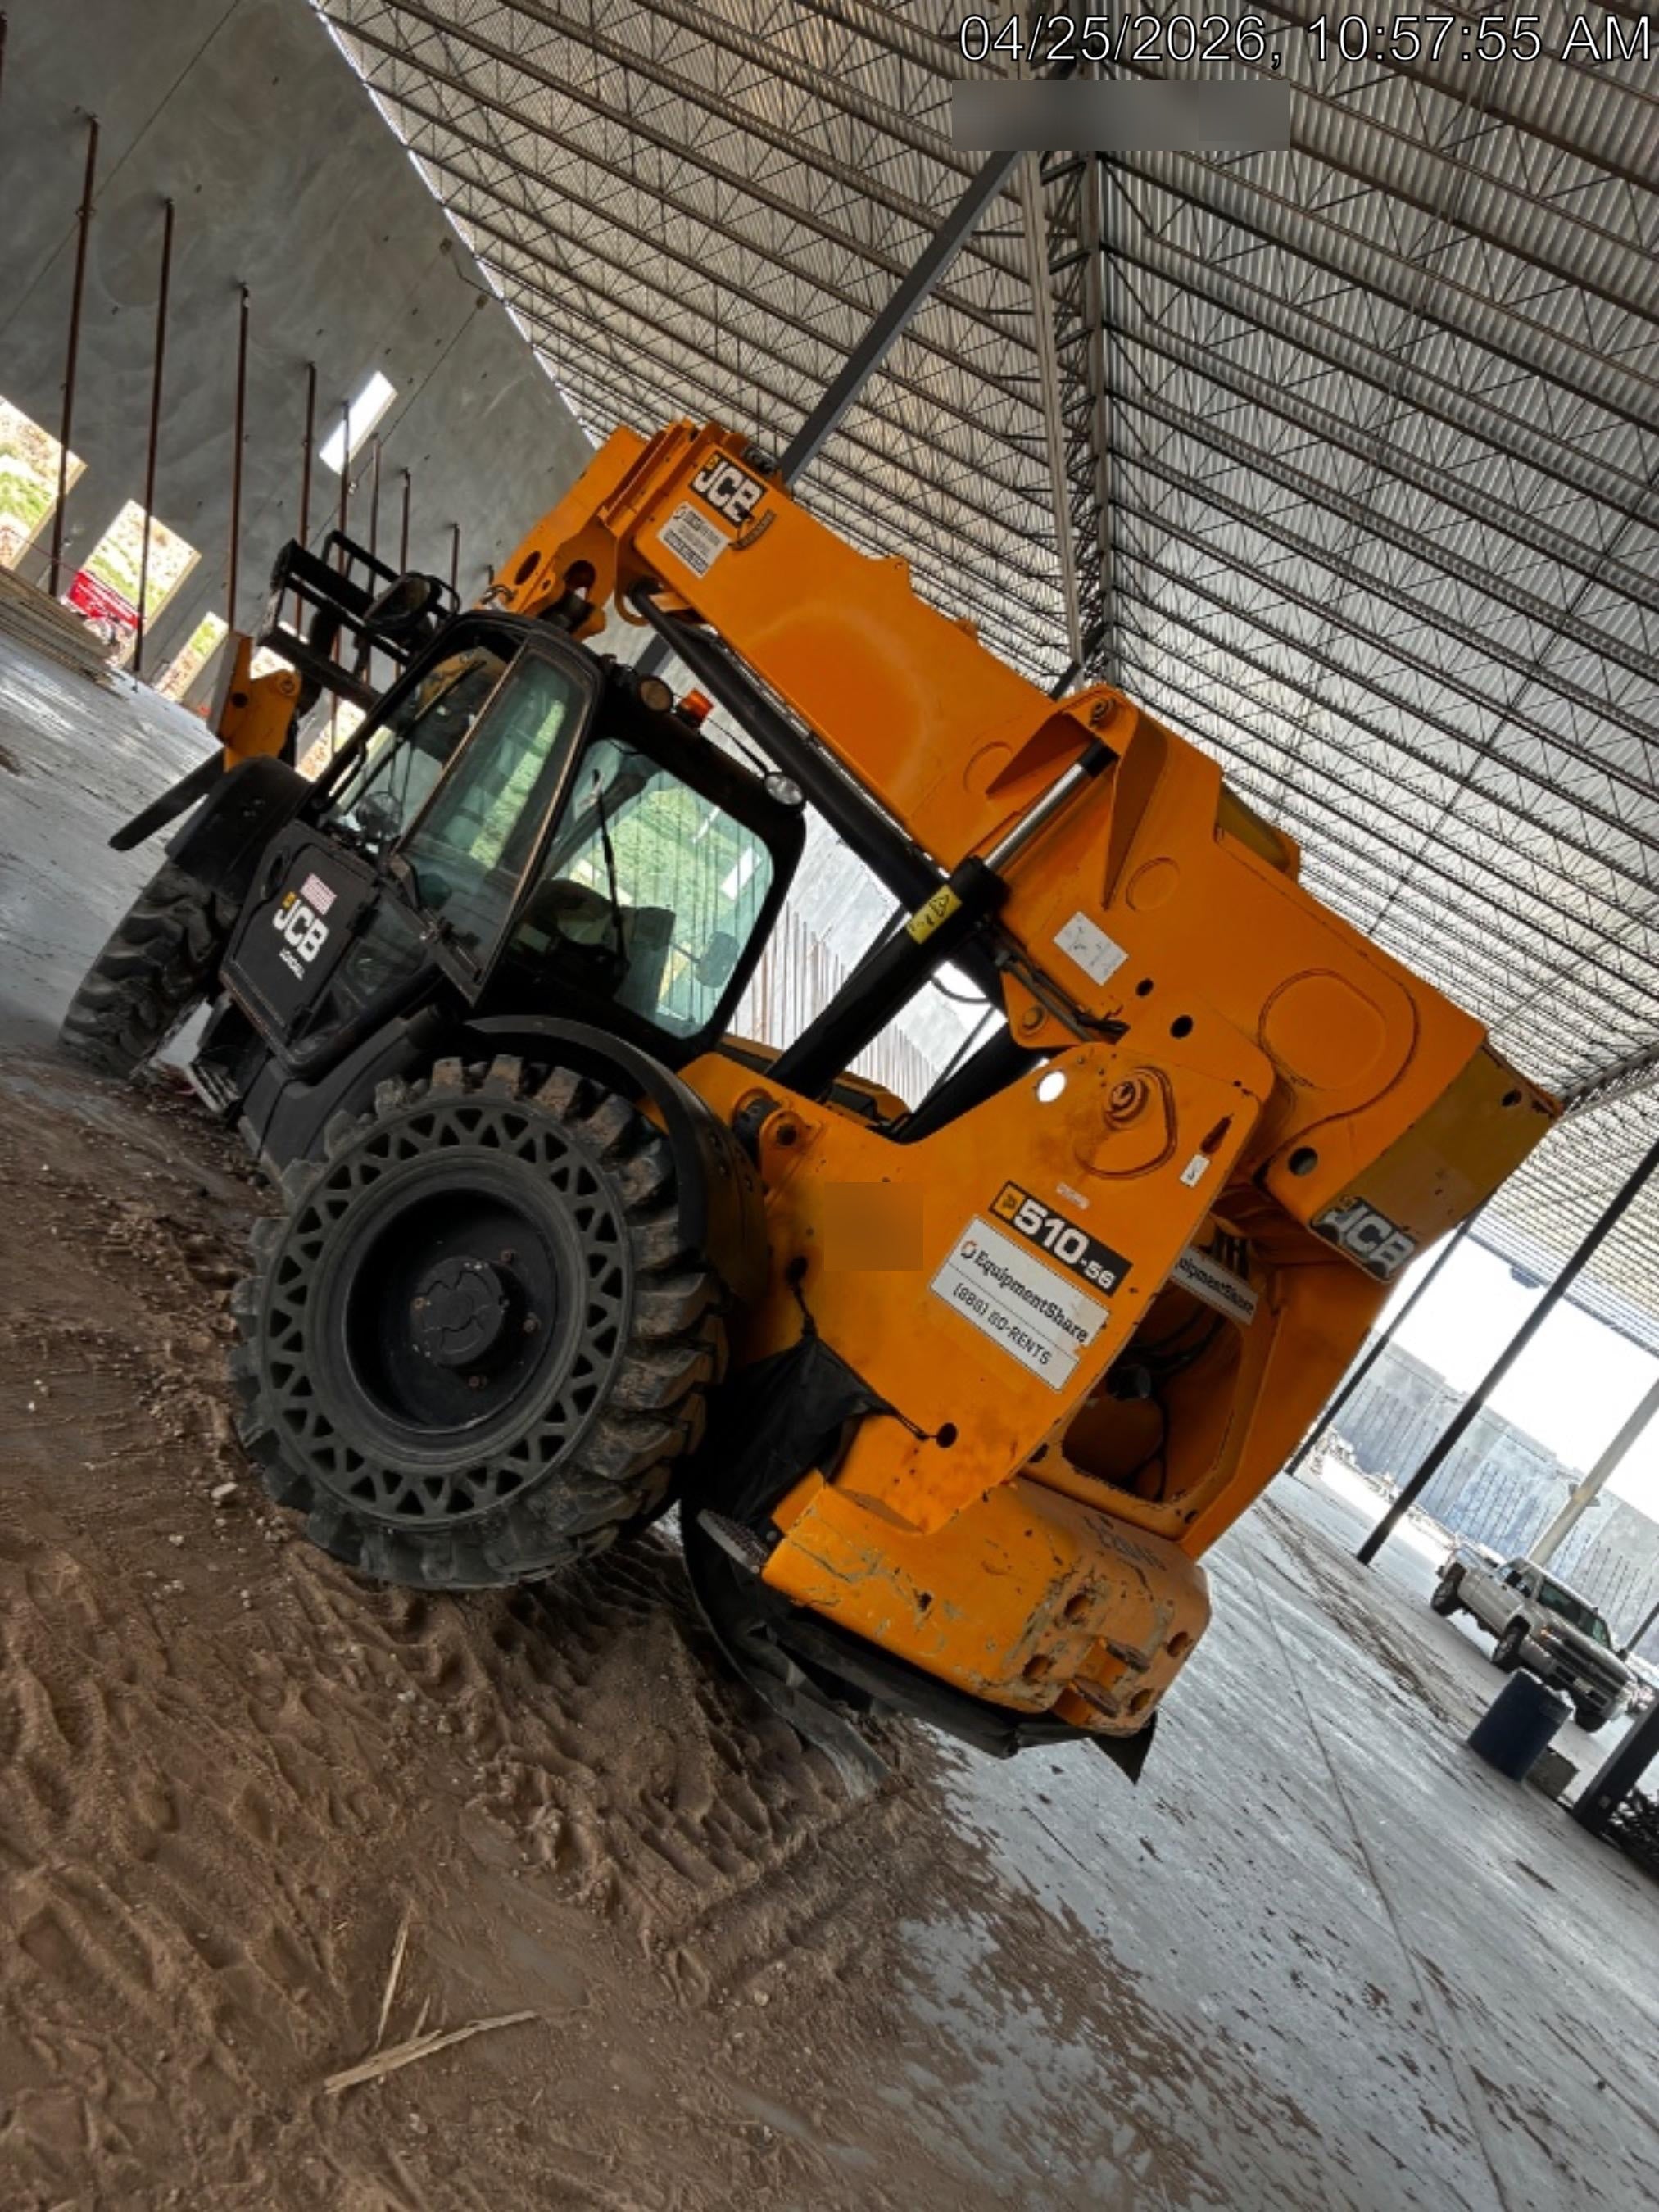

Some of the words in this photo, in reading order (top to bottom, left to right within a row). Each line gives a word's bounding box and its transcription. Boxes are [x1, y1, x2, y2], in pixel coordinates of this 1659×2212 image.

[692, 459, 764, 522] JCB
[272, 899, 330, 963] JCB
[1321, 1203, 1416, 1279] JCB
[973, 1249, 1090, 1344] EquipmentShare
[1175, 1255, 1255, 1316] uipmentShare
